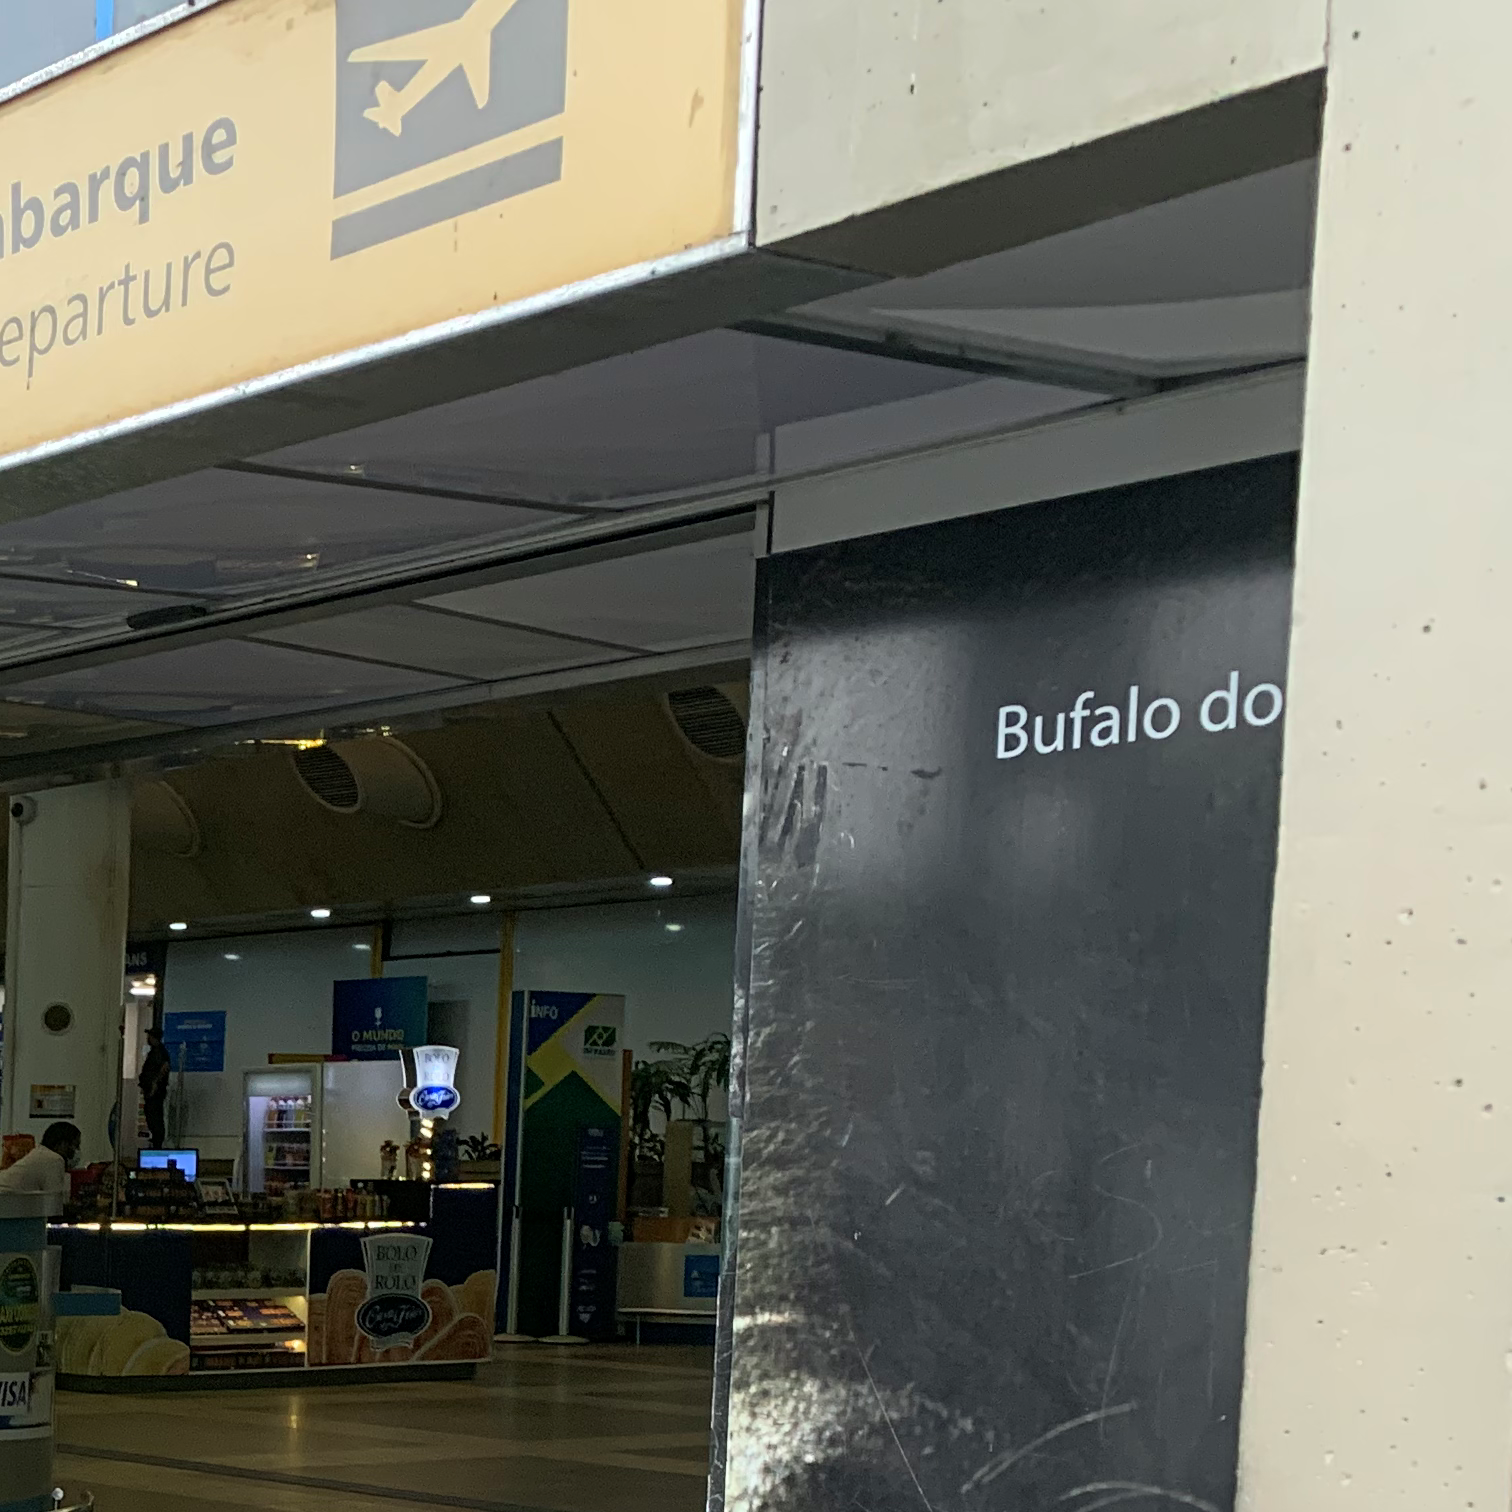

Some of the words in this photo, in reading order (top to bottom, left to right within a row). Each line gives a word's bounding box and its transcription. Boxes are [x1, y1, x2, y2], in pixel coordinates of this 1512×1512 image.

[996, 685, 1181, 760] Bufalo
[1199, 670, 1284, 732] do
[376, 1245, 418, 1261] BOLO
[375, 1274, 417, 1290] ROLO
